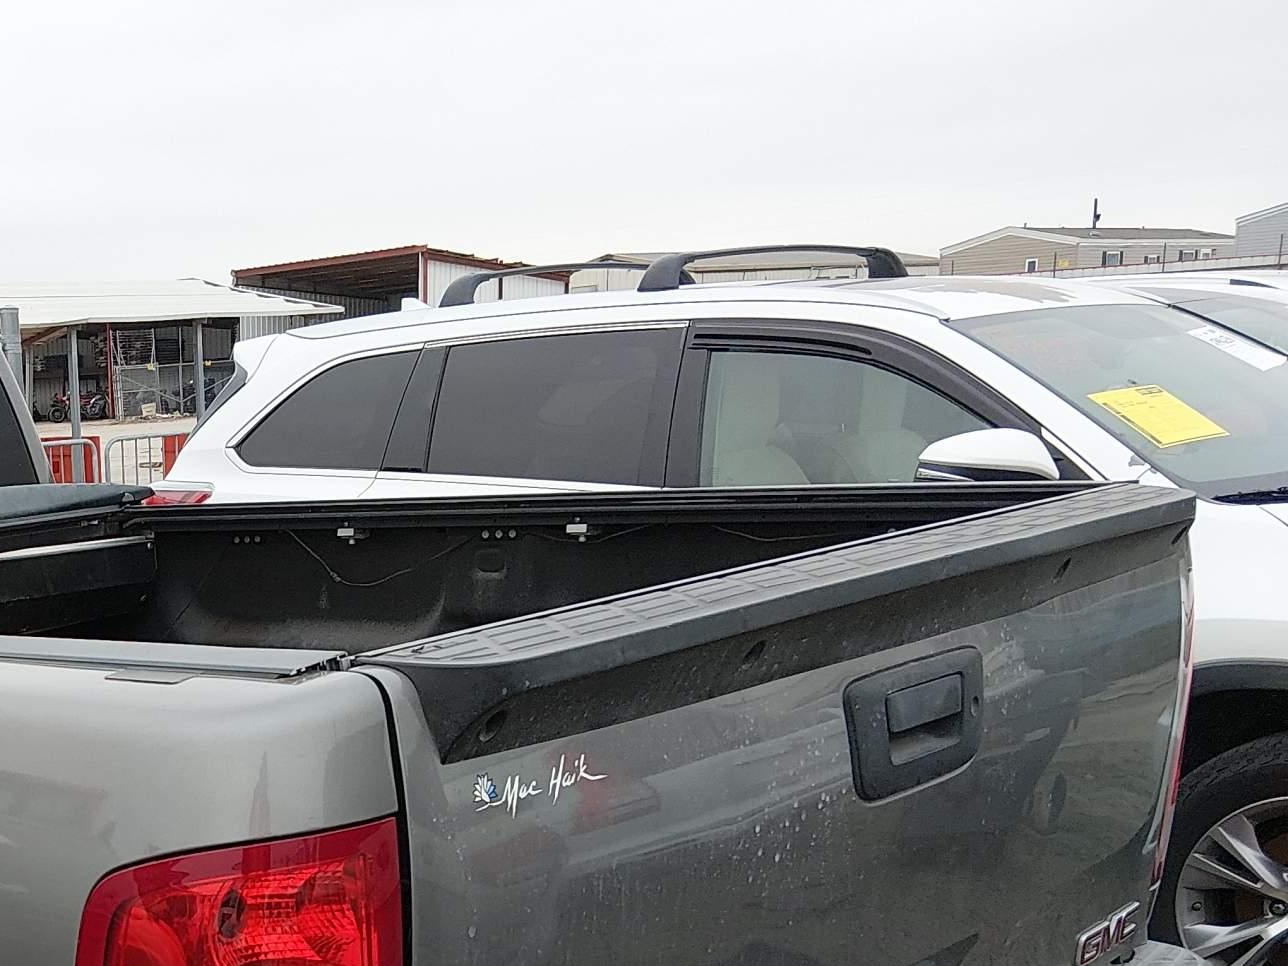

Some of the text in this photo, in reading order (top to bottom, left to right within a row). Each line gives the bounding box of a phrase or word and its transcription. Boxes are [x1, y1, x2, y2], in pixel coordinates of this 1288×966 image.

[486, 753, 609, 820] Mac Haik
[1074, 901, 1141, 966] GMC
